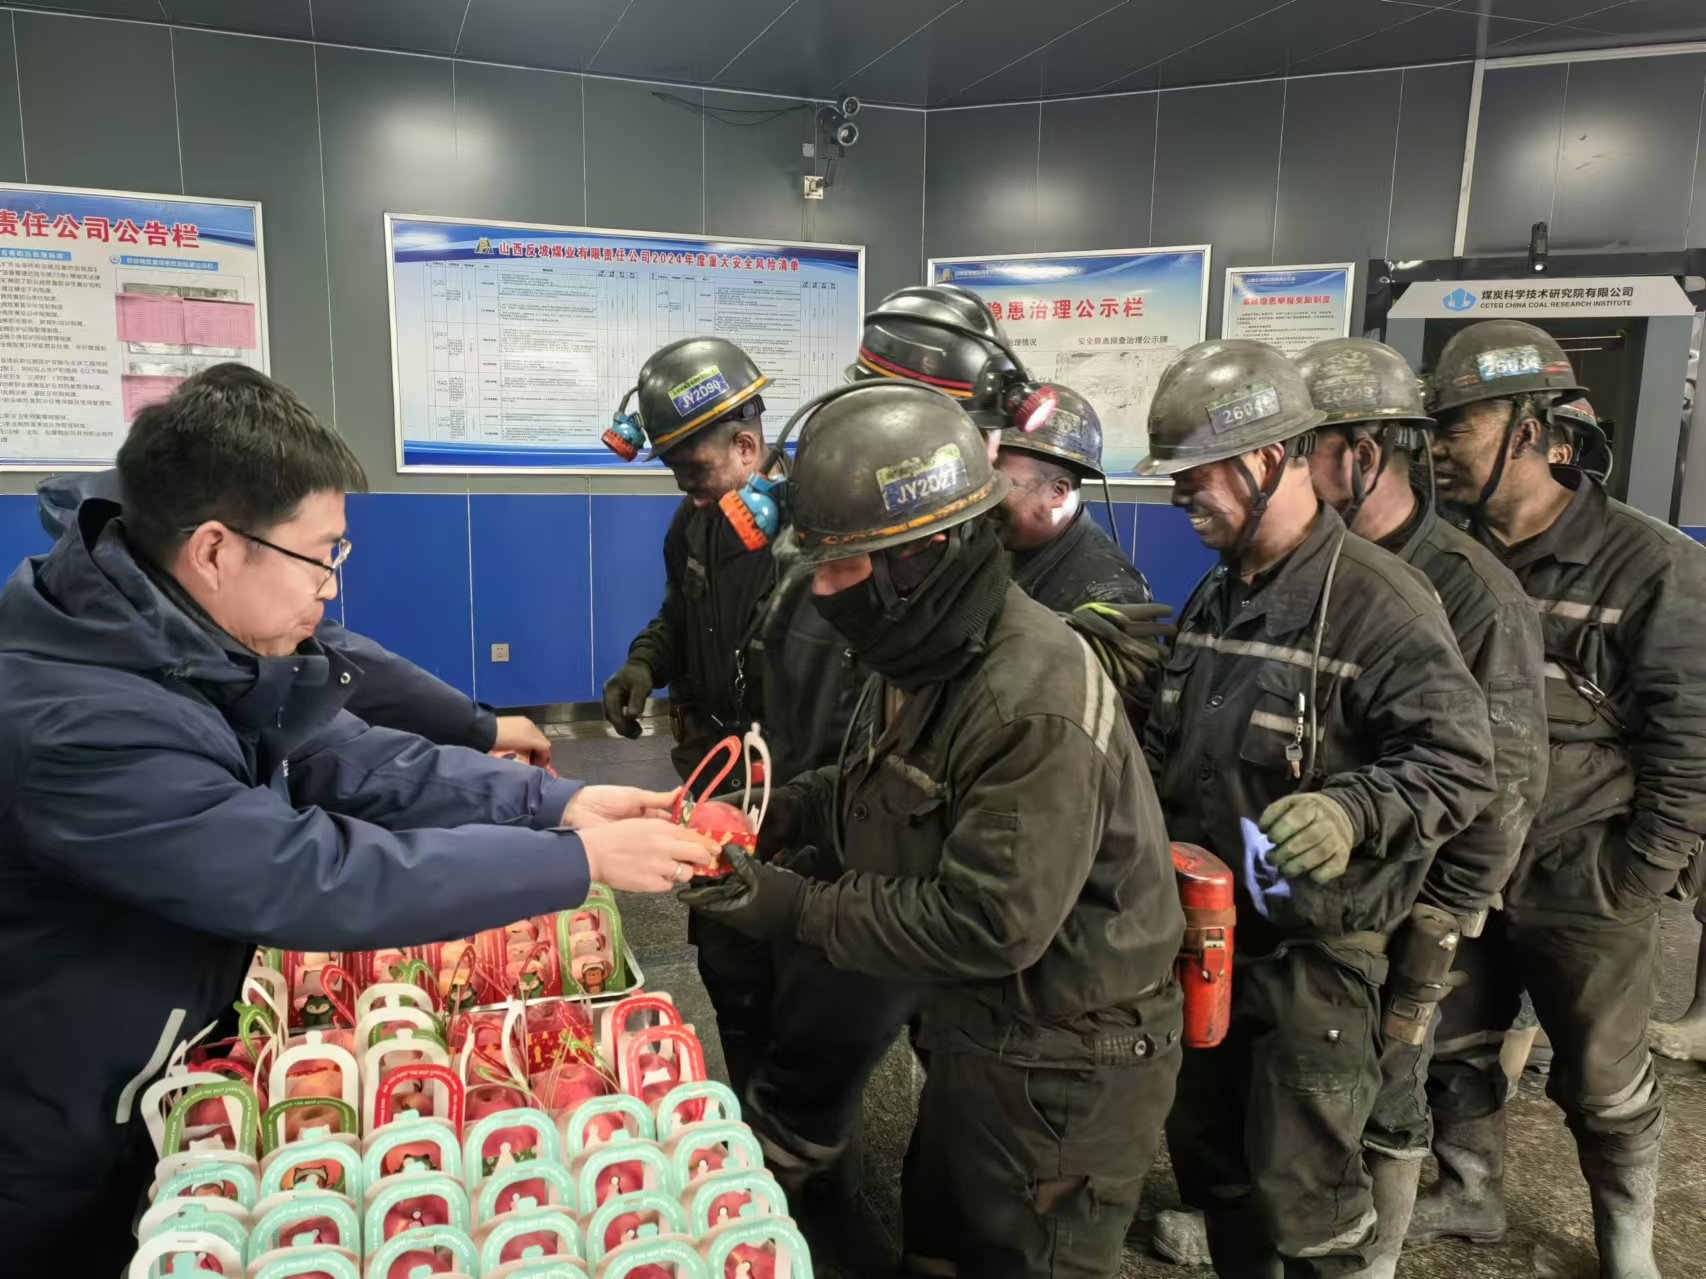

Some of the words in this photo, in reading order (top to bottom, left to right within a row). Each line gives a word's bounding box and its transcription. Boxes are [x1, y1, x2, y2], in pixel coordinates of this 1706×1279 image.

[0, 211, 200, 249] 责任公司公告栏
[498, 242, 800, 272] 山西反坡煤业有限责任公司2024年度重大安全风险清单
[1481, 287, 1634, 300] 煤炭科学技术研究院有限公司
[987, 297, 1145, 321] 隐患治理公示栏
